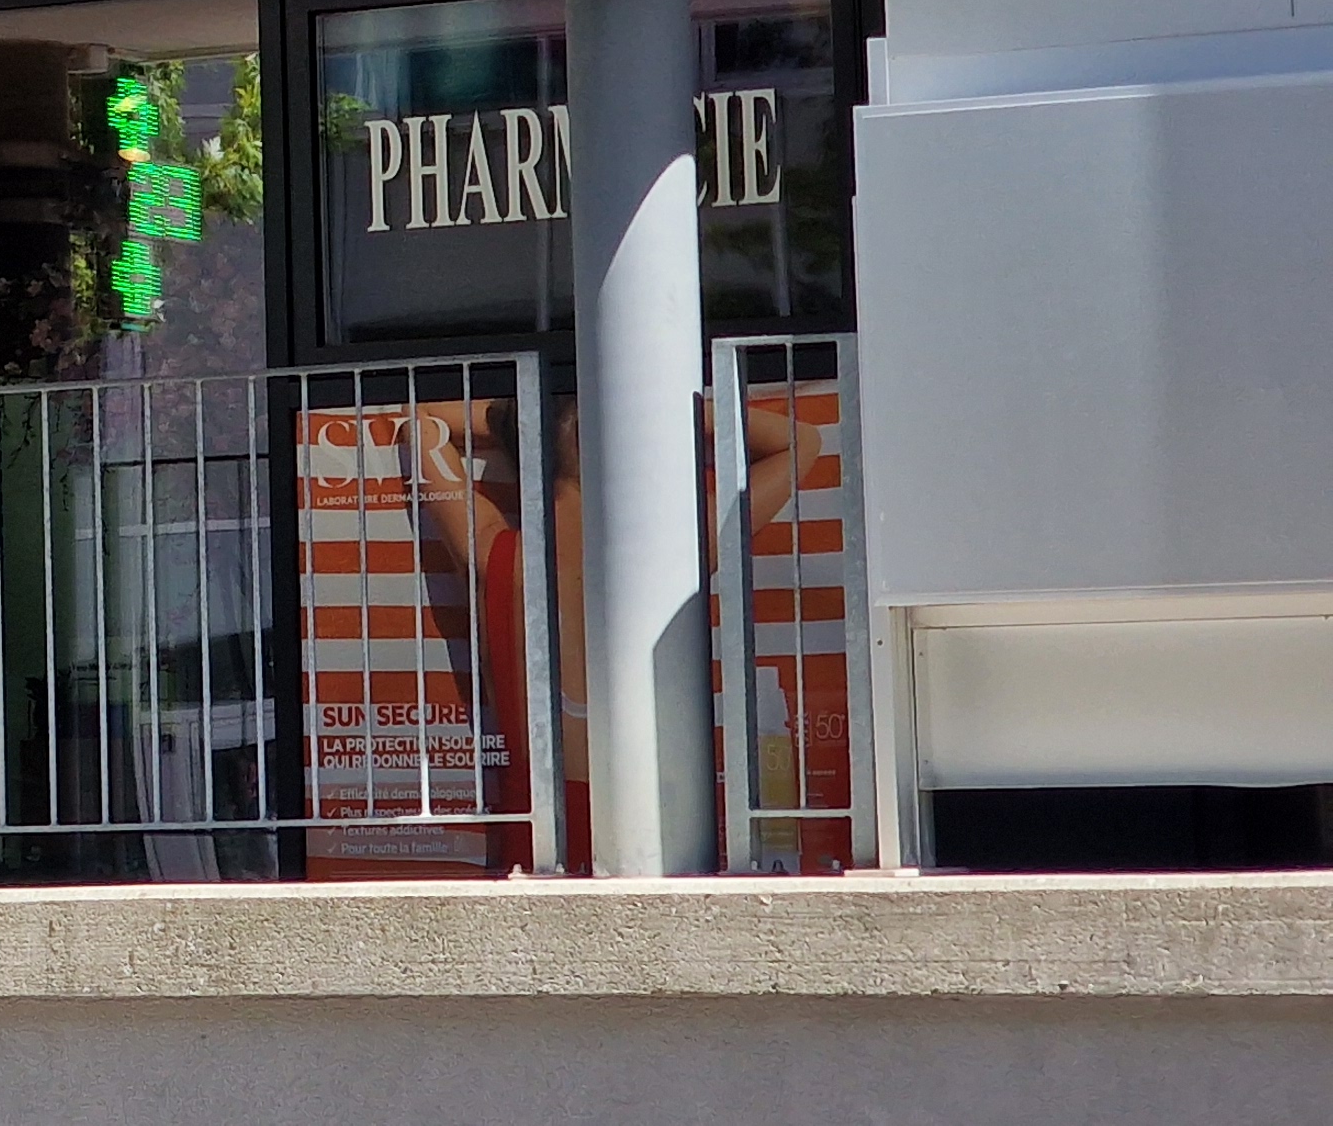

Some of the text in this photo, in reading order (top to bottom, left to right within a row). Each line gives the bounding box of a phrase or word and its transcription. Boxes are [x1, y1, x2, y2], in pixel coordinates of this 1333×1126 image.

[364, 88, 781, 232] PHARIE
[317, 416, 463, 488] SVR
[317, 489, 465, 506] LABORATIRE DERMAOLOGIQUE
[323, 703, 469, 727] SUN SECURE
[323, 739, 344, 753] LA
[346, 736, 439, 752] PRTECTIN
[323, 755, 348, 770] QUI
[429, 752, 443, 767] LE
